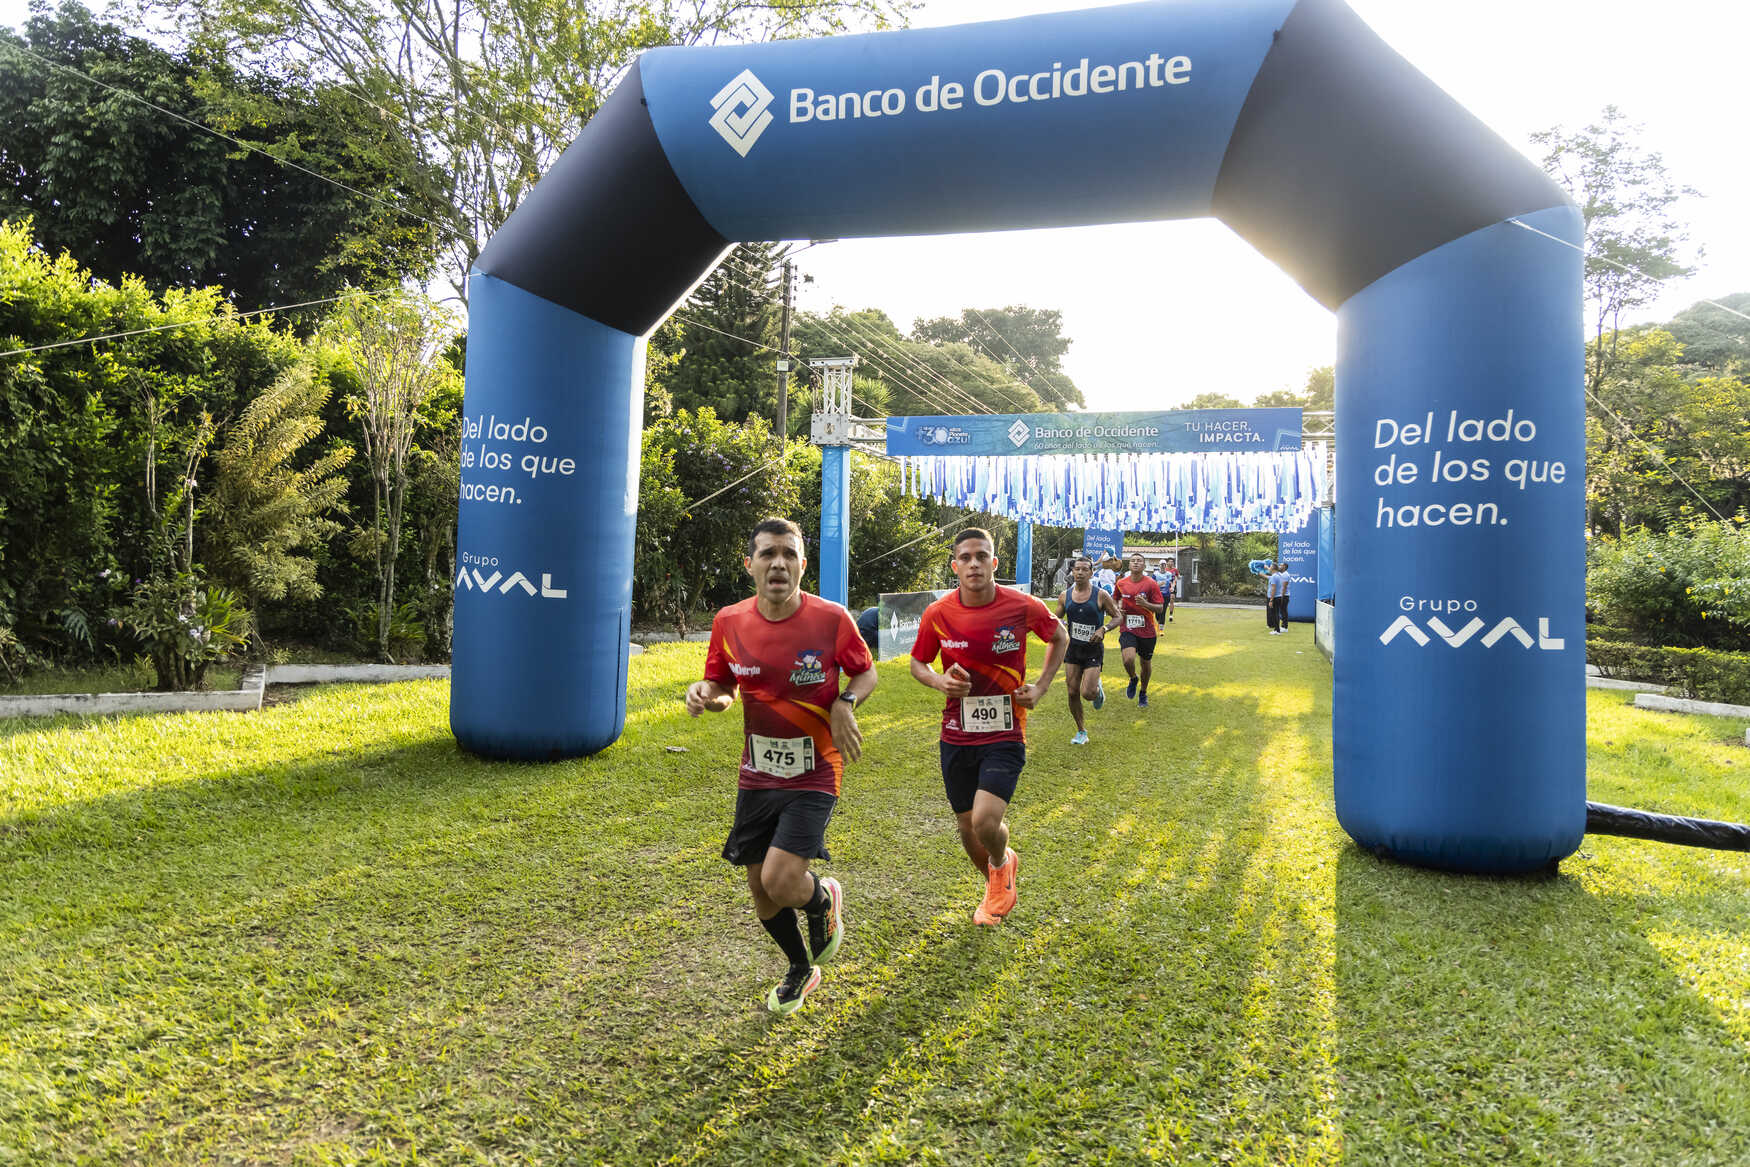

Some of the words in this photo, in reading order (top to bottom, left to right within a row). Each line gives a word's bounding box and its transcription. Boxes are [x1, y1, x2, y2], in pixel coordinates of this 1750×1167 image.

[789, 87, 906, 123] Banco
[915, 75, 963, 112] de
[973, 52, 1192, 107] Occidente
[462, 415, 484, 439] Del
[488, 415, 548, 443] lado
[1035, 426, 1073, 438] Banco
[1076, 426, 1092, 438] de
[1094, 425, 1159, 437] Occidente
[1184, 421, 1200, 432] TU
[1205, 421, 1252, 431] HACER.
[1200, 432, 1265, 443] IMPACTA.
[1374, 411, 1434, 449] Del
[1447, 409, 1537, 442] lado
[461, 444, 475, 468] de
[479, 444, 513, 470] los
[521, 454, 576, 479] que
[1374, 453, 1418, 486] de
[1431, 450, 1491, 483] los
[1504, 458, 1566, 490] que
[460, 476, 522, 504] hacen.
[1376, 497, 1508, 529] hacen.
[462, 551, 499, 567] Grupo
[456, 566, 568, 599] AVAL
[1289, 576, 1316, 584] VAL
[1400, 596, 1478, 614] Grupo
[1379, 615, 1565, 650] AVAL
[971, 707, 998, 720] 490
[763, 749, 796, 766] 475
